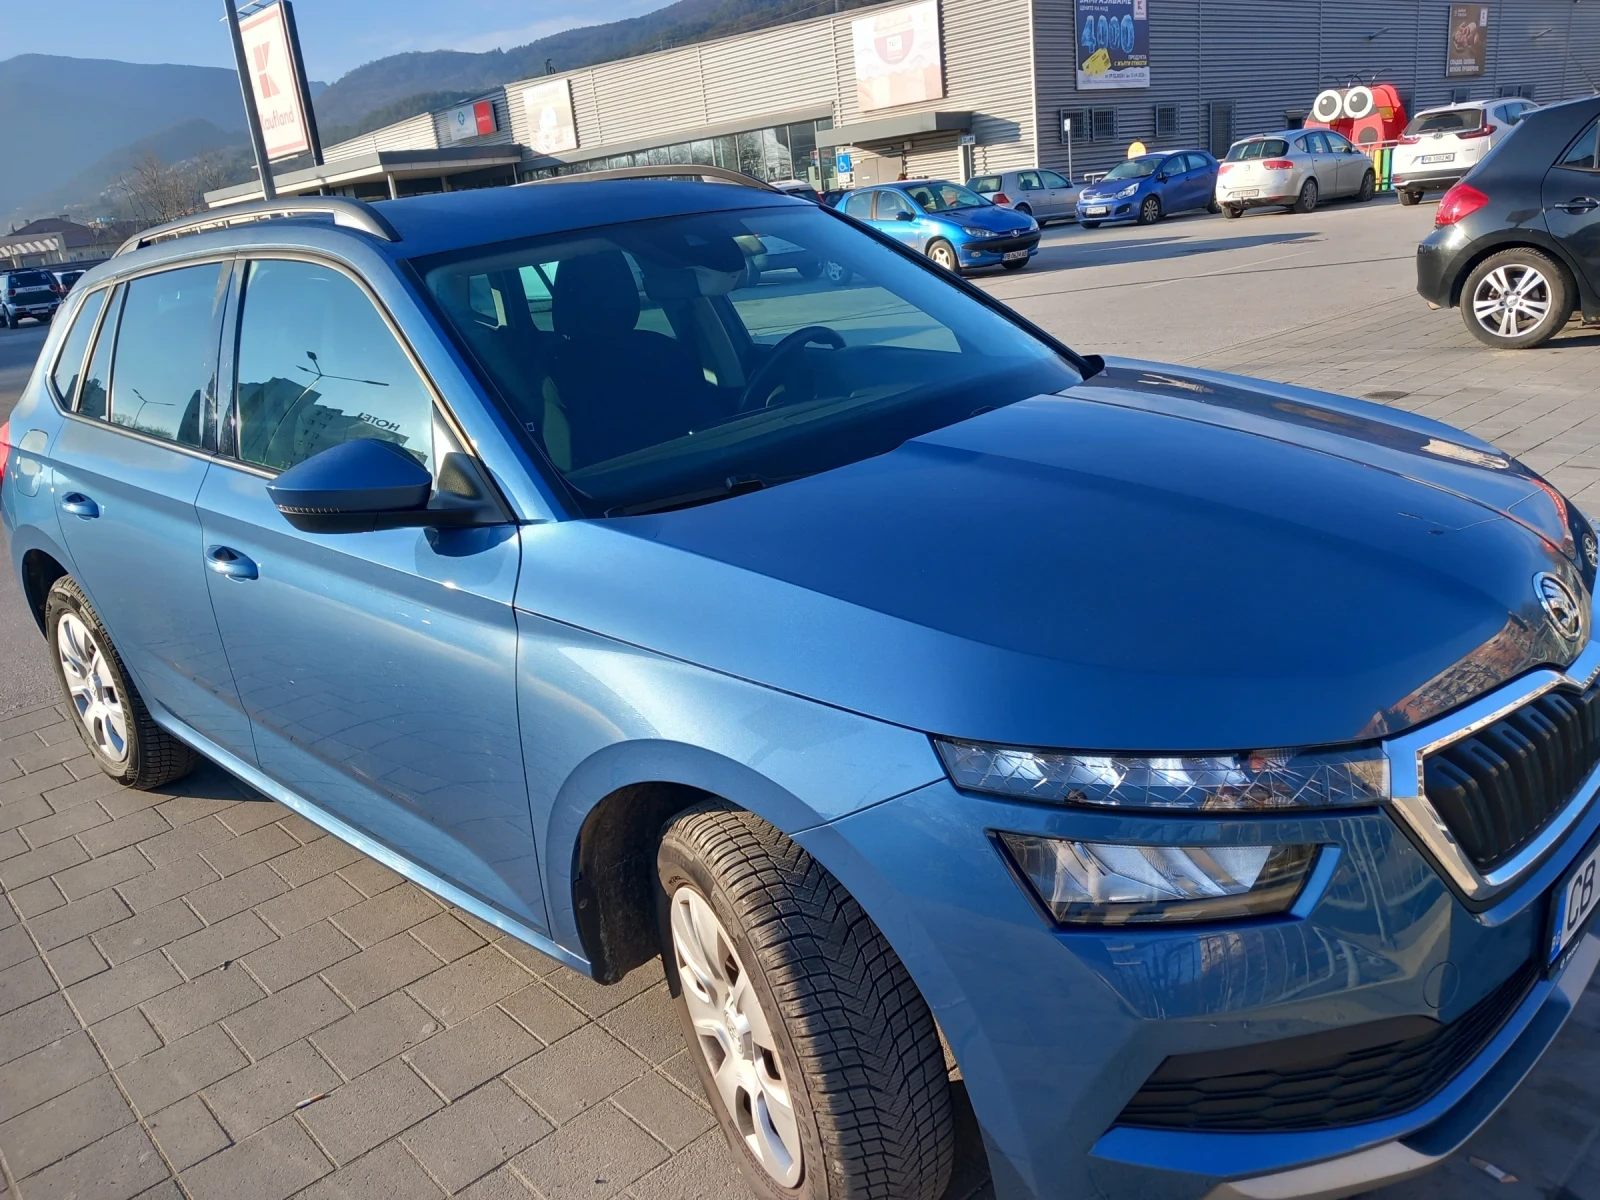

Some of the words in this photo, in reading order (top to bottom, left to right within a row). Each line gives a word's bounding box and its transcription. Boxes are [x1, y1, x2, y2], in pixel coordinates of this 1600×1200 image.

[1081, 14, 1135, 53] 4000
[259, 105, 295, 131] Kaufland
[1566, 858, 1596, 932] CB
